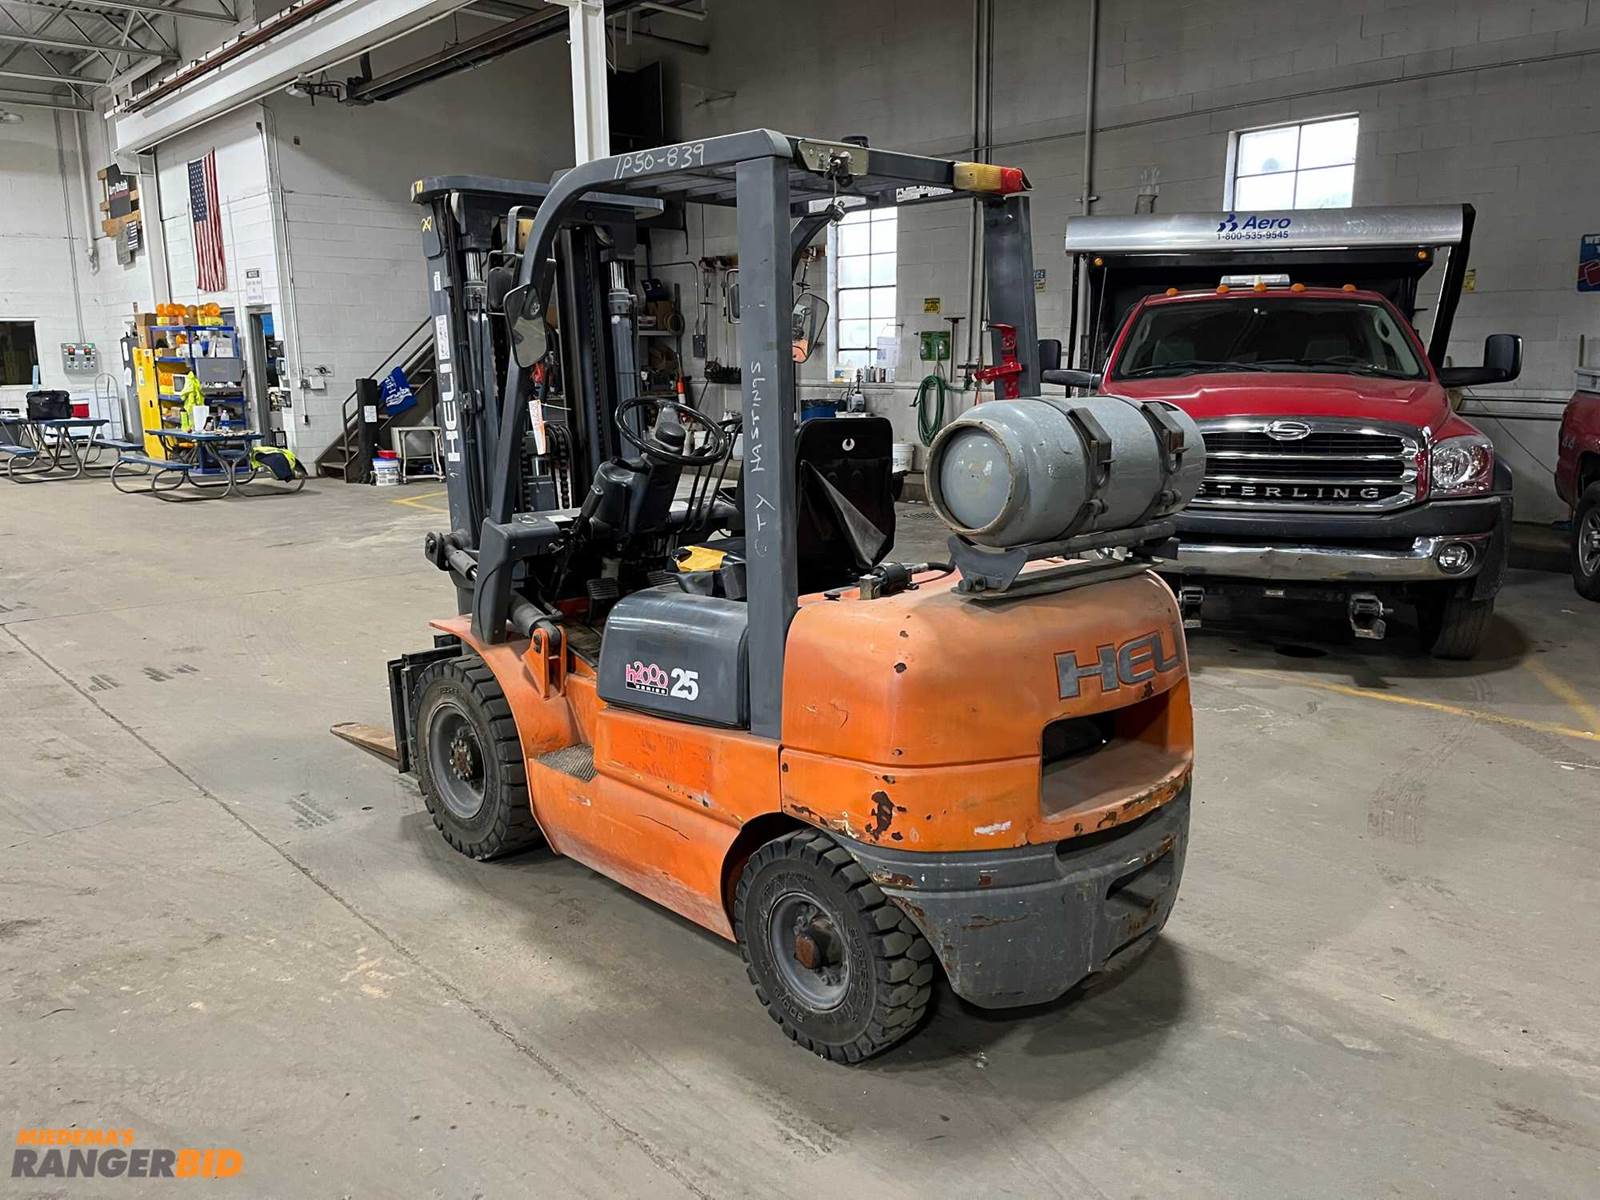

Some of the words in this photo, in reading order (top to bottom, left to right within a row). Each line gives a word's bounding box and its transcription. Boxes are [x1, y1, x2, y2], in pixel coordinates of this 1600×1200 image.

[1241, 215, 1291, 230] Aero
[1217, 230, 1289, 240] 1-800-535-9545
[439, 363, 461, 462] HELI
[670, 667, 699, 701] 25
